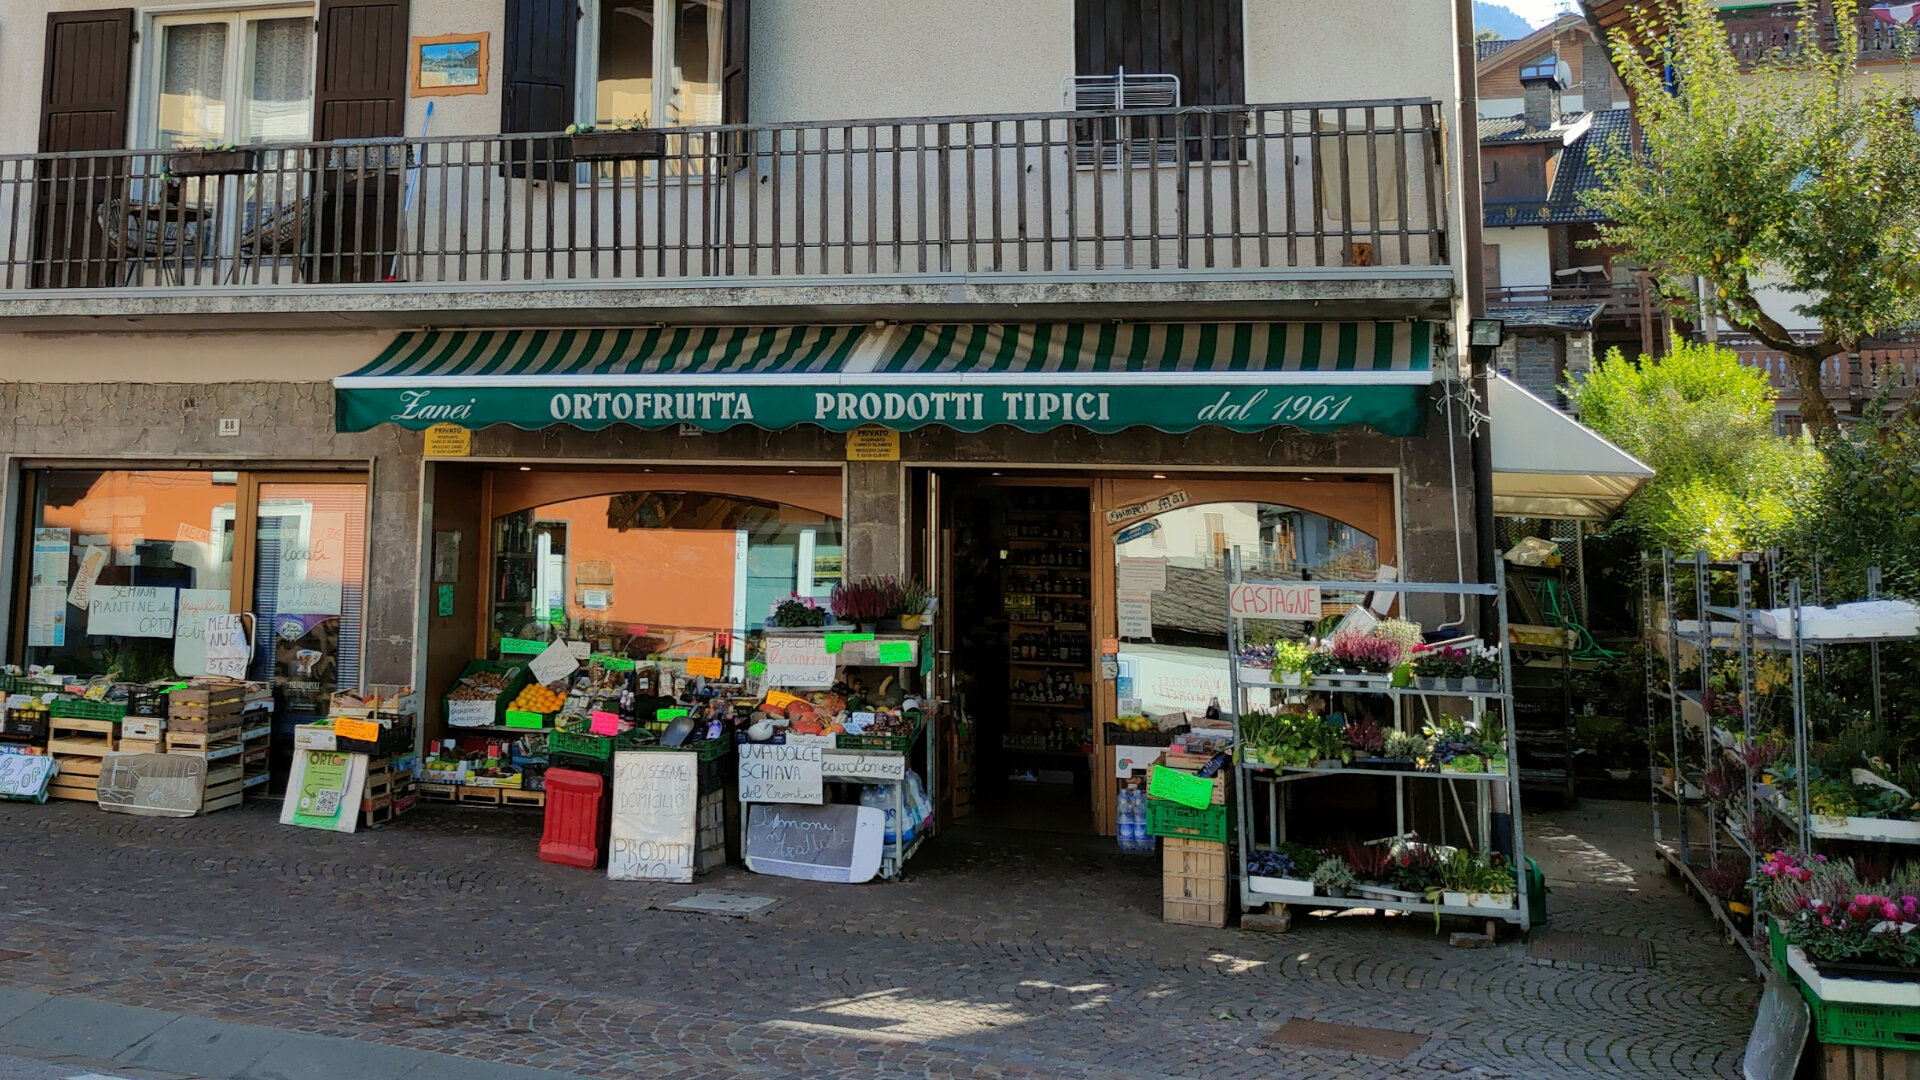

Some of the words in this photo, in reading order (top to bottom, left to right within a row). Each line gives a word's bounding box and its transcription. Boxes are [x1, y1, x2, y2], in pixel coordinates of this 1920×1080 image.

[390, 390, 476, 421] Zanei
[550, 393, 754, 420] ORTOFRUTTA
[815, 393, 985, 420] PRODOTTI
[1002, 392, 1110, 420] TIPICI
[1197, 388, 1268, 421] dal
[1271, 394, 1353, 421] 1961
[224, 420, 235, 430] 88
[111, 587, 156, 600] SEMINA
[1230, 585, 1317, 615] CASTAGNE
[93, 600, 153, 614] PIANTINE
[139, 618, 173, 633] ORTO
[769, 671, 832, 686] speciali
[739, 745, 773, 760] UVA
[777, 746, 820, 762] DOLCE
[622, 762, 688, 781] CONSEGNE
[740, 763, 801, 780] SCHIAVA
[641, 782, 658, 791] AL
[742, 785, 762, 799] del
[620, 792, 685, 809] DOMICILIO
[613, 838, 694, 869] PRODOTTI
